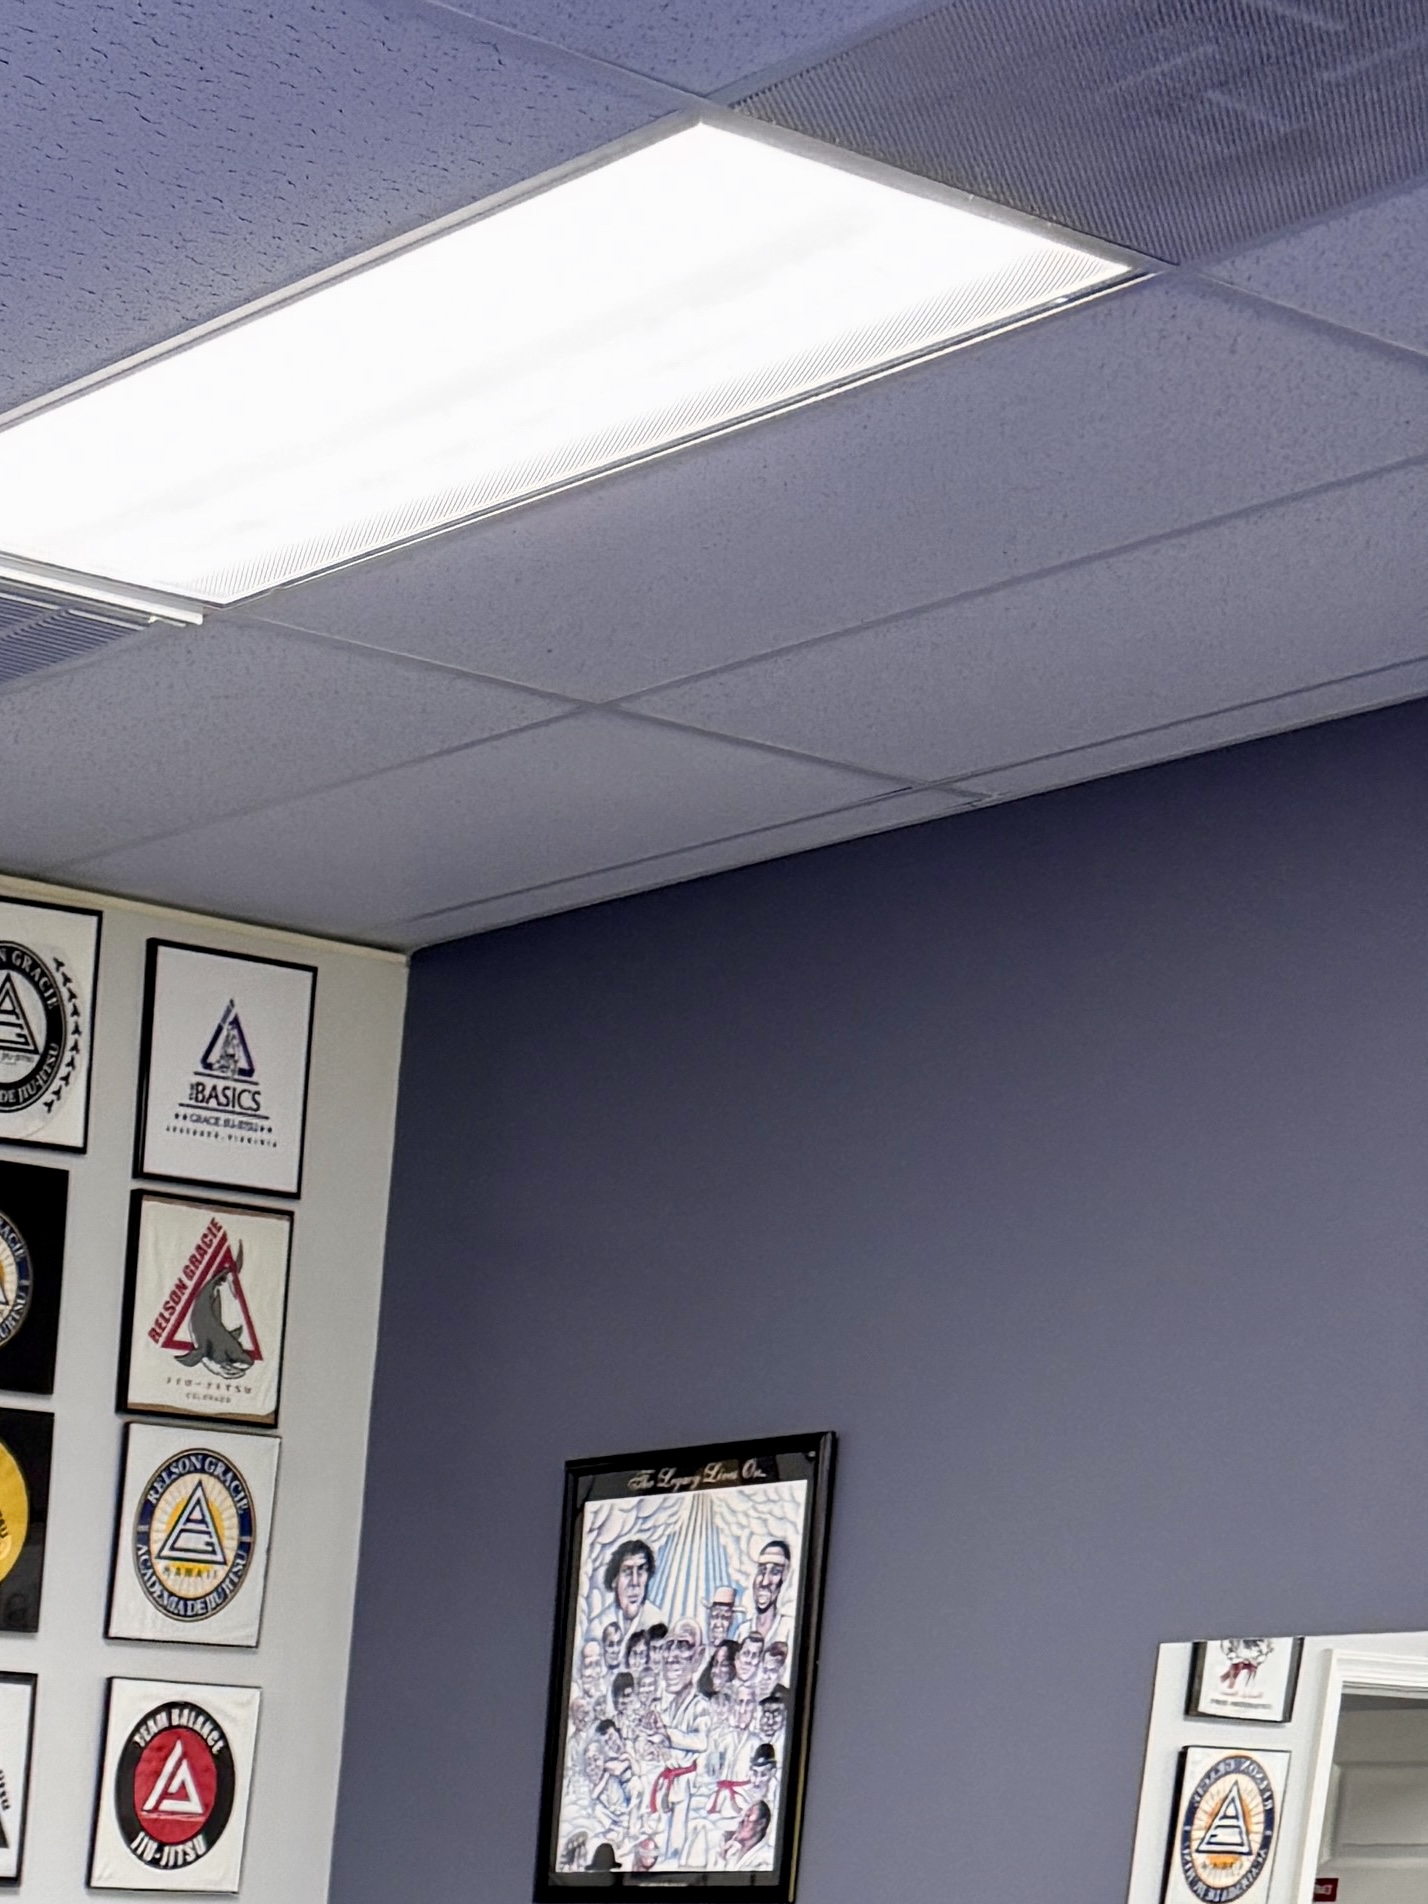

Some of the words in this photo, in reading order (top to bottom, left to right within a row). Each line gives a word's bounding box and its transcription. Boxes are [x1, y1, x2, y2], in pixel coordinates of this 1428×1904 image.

[11, 951, 60, 1010] GRACIE
[195, 1081, 262, 1112] BASICS
[147, 1277, 189, 1345] RELSON
[182, 1217, 223, 1281] GRACIE
[147, 1455, 203, 1504] RELSON
[204, 1457, 250, 1514] GRACIE
[136, 1543, 186, 1616] ACADEMIA
[186, 1600, 206, 1616] DE
[133, 1708, 170, 1749] TEAM
